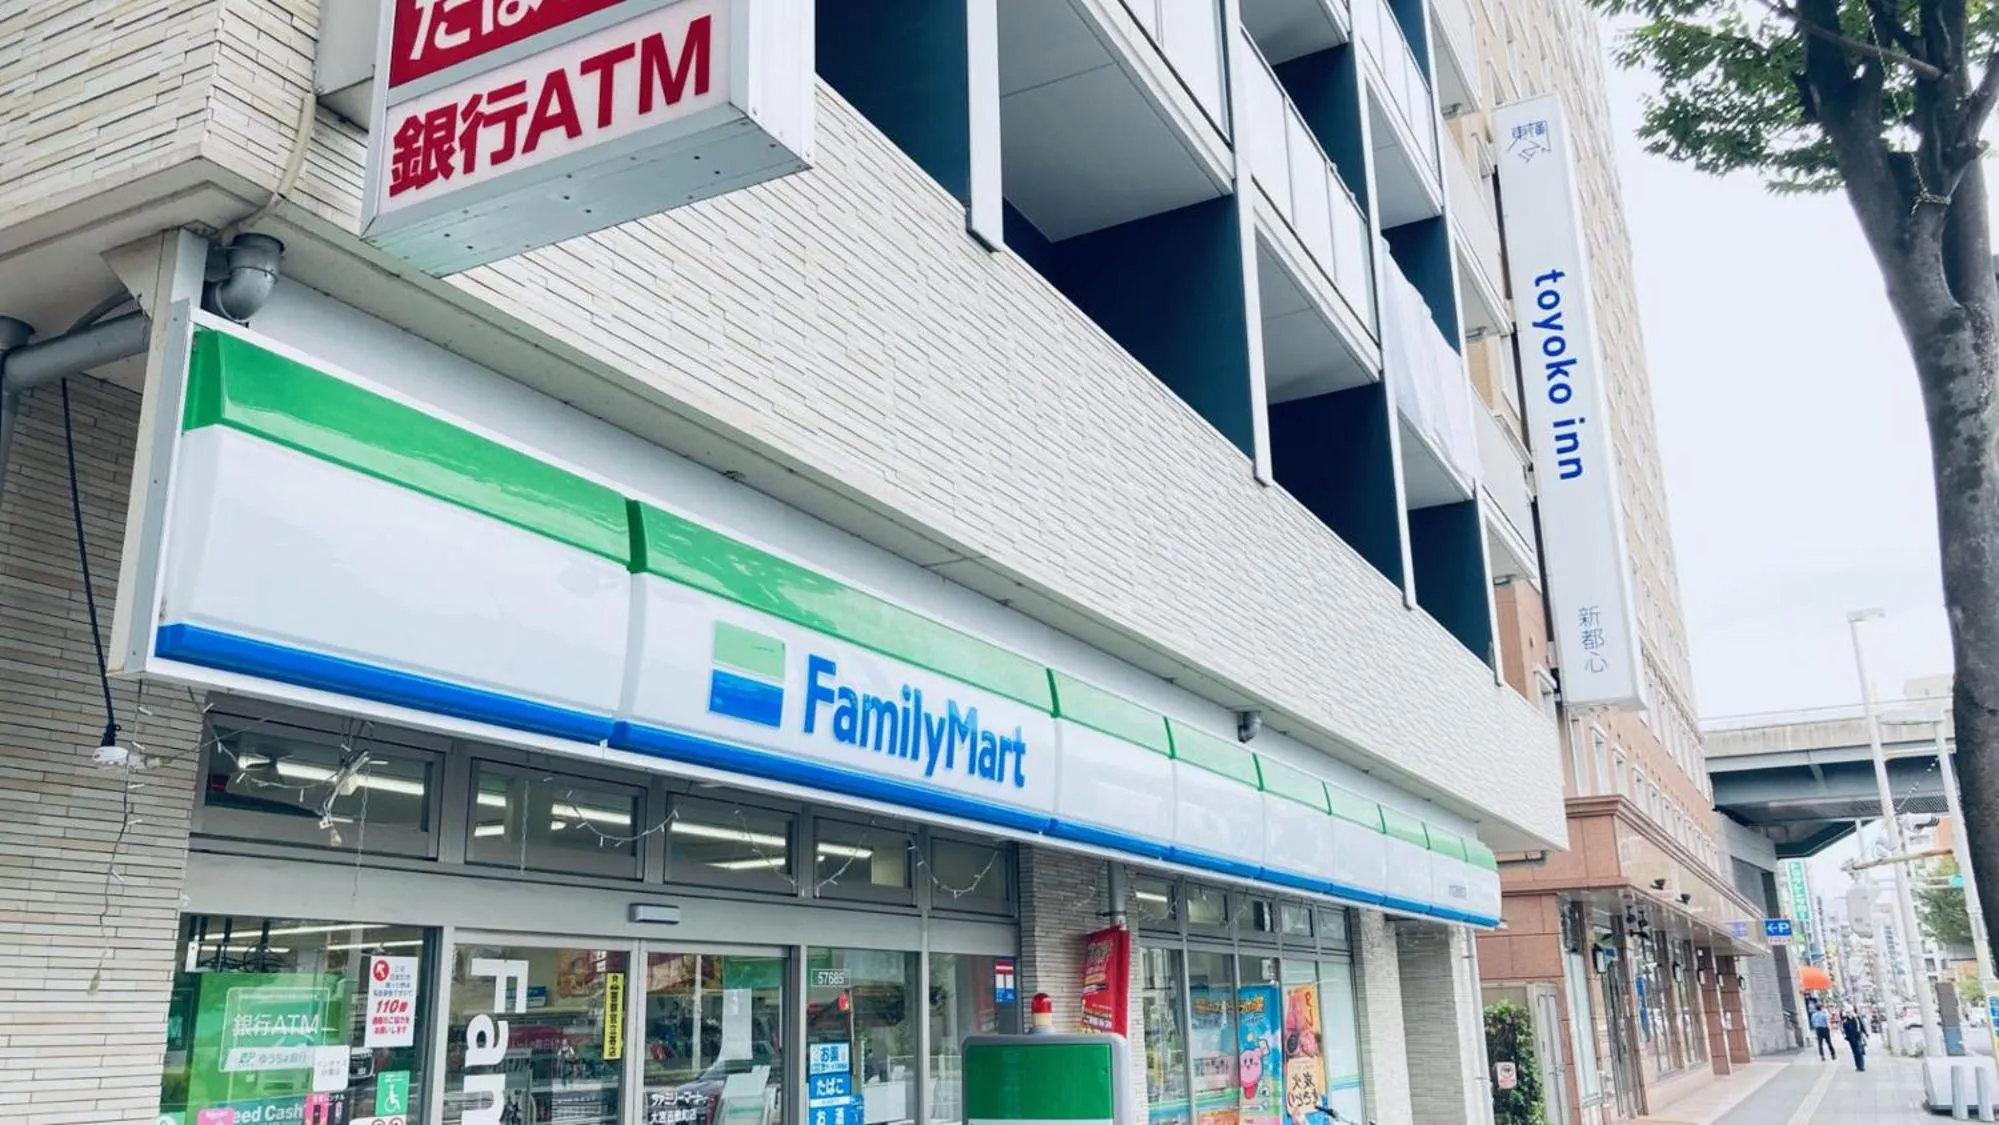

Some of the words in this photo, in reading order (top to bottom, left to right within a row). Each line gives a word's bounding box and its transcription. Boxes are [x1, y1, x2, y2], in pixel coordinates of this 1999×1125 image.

[389, 14, 713, 198] 銀行ATM
[1532, 268, 1577, 406] toyoko
[1552, 415, 1586, 482] inn
[1577, 605, 1609, 674] 新都心
[802, 653, 1027, 788] FamilyMart
[1778, 922, 1790, 933] P
[232, 1013, 320, 1037] 銀行ATM
[264, 1102, 303, 1122] Cash
[816, 1077, 845, 1097] たばこ
